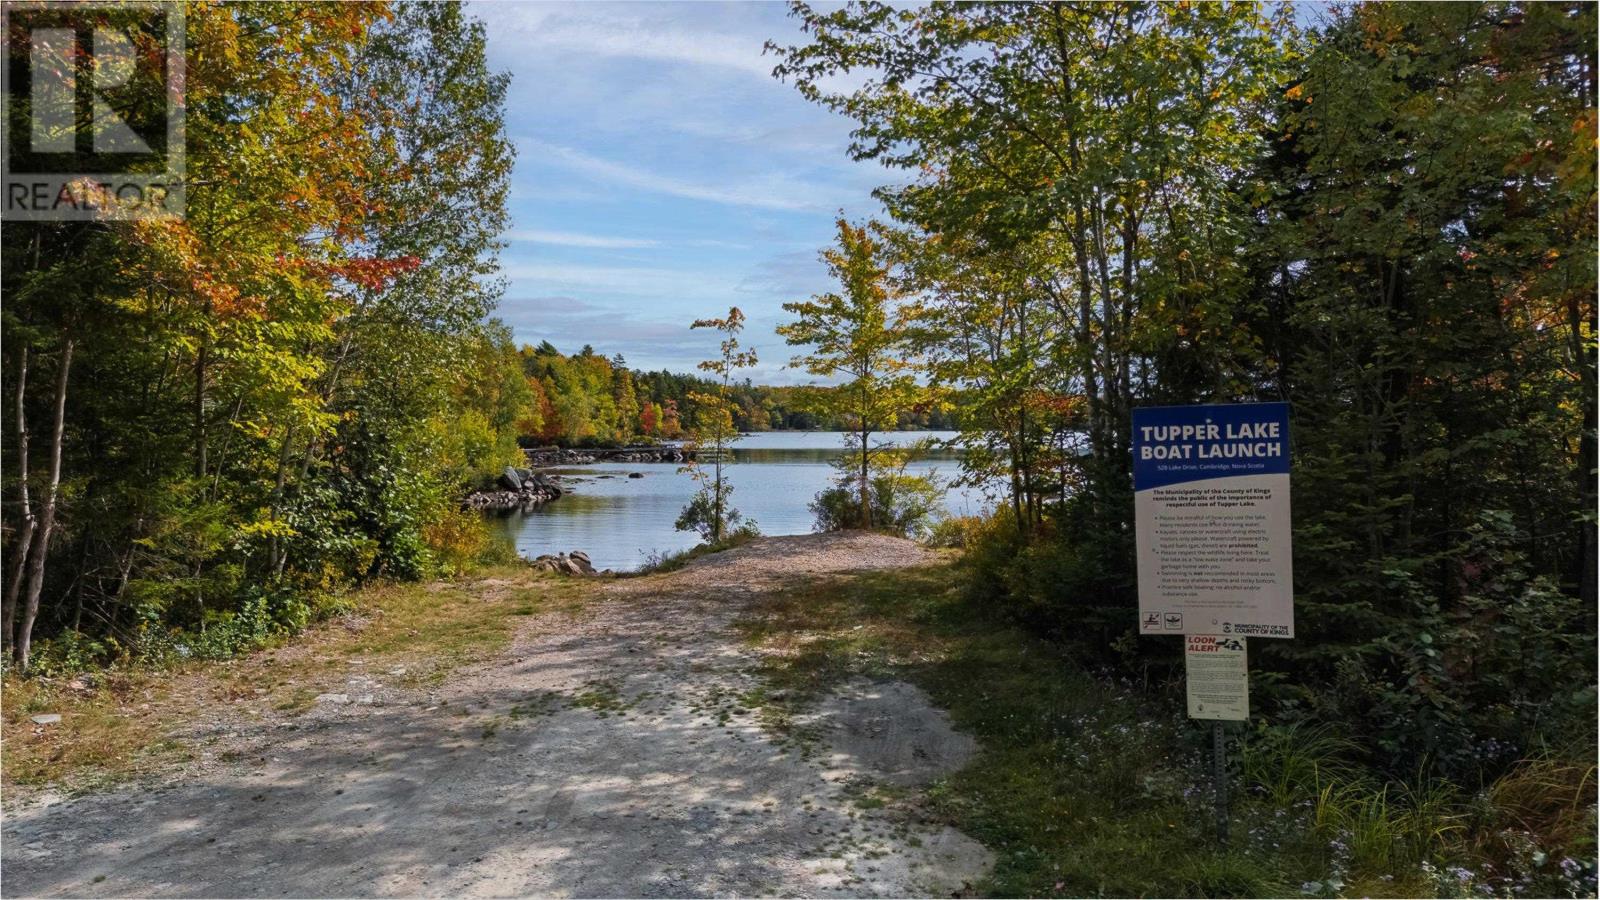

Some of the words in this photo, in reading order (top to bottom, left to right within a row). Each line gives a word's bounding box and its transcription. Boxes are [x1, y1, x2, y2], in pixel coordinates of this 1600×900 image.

[1141, 424, 1221, 441] TUPPER
[1226, 422, 1280, 439] LAKE
[1141, 445, 1193, 460] BOAT
[1198, 442, 1281, 458] LAUNCH
